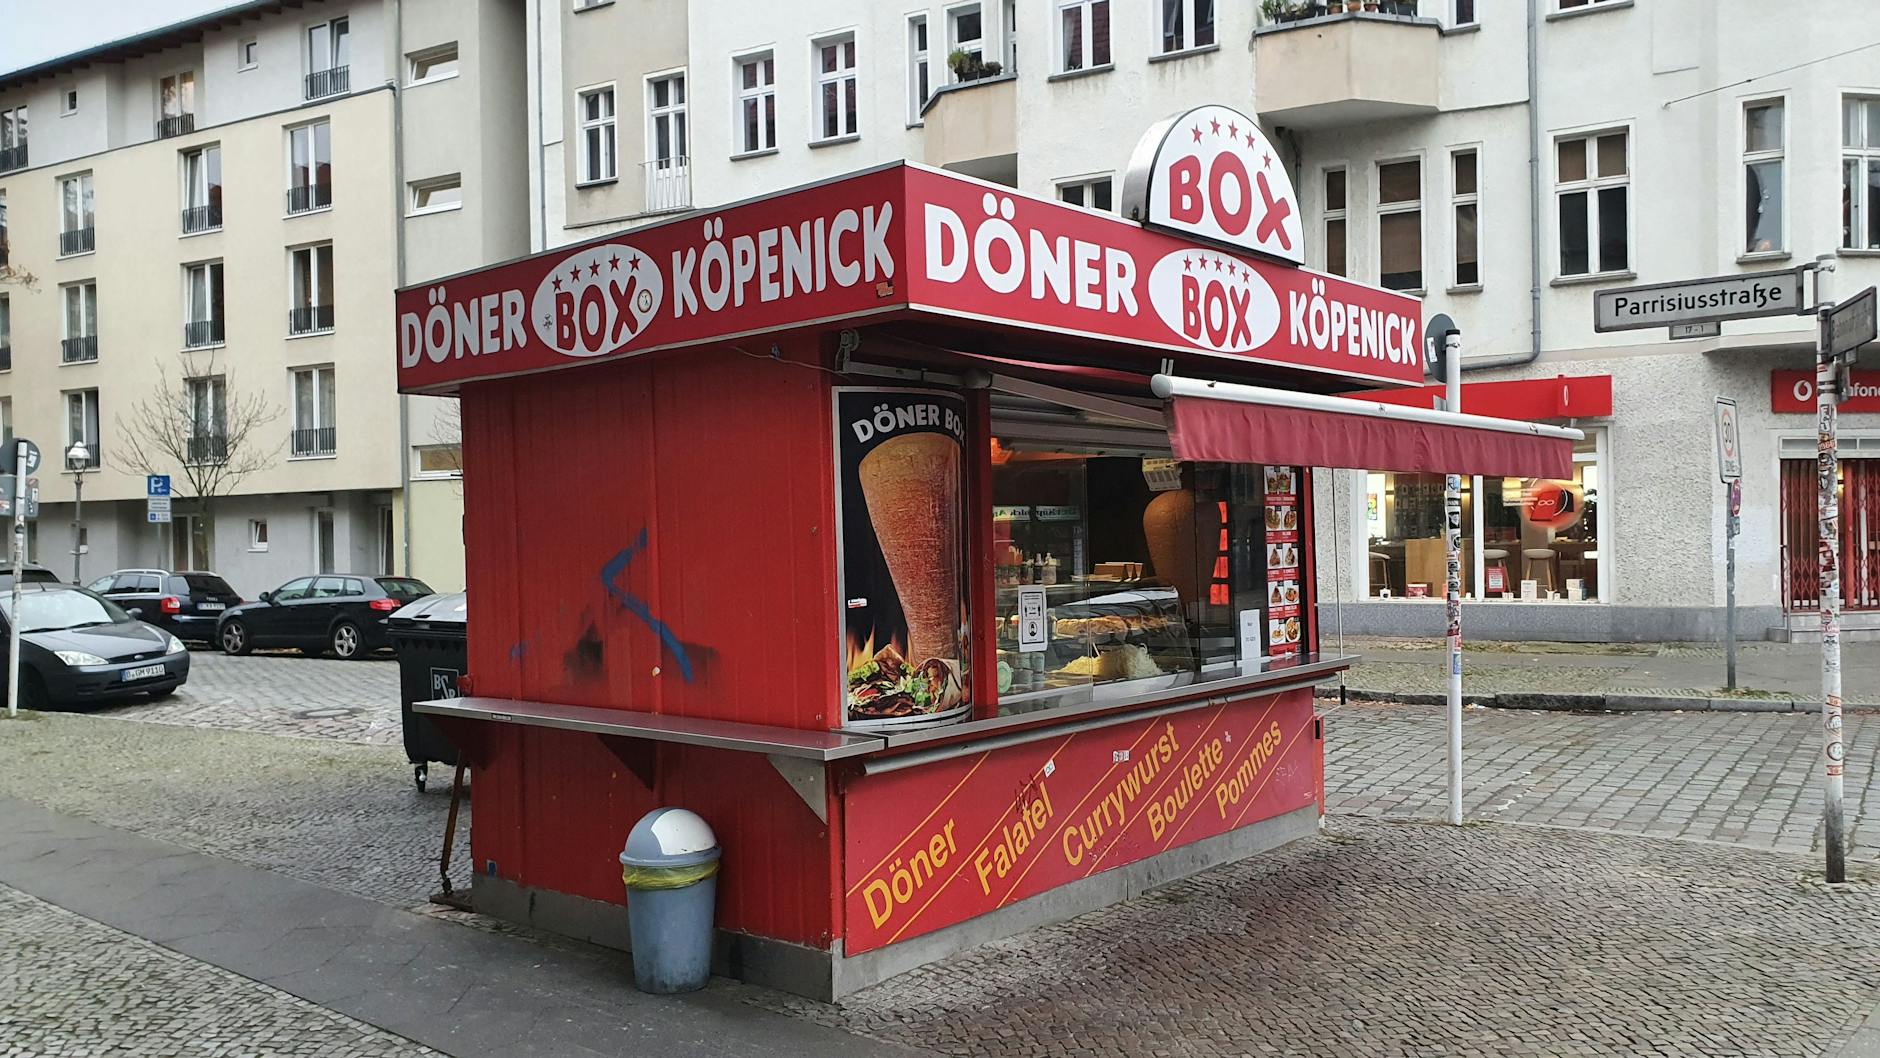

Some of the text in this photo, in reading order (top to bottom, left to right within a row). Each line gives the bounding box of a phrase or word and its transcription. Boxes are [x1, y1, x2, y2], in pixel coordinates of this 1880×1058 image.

[1168, 150, 1292, 251] BOX
[400, 200, 895, 369] DÖNER BOX KÖPENICK
[924, 192, 1417, 367] DÖNER BOX KÖPENICK
[1614, 282, 1782, 317] Parrisiusstraße
[851, 403, 965, 447] DÖNER BOX
[1062, 721, 1179, 867] Currywurst
[1147, 738, 1224, 842] Boulette
[1215, 720, 1282, 820] Pommes
[862, 819, 958, 929] Döner
[974, 783, 1053, 895] Falafel
